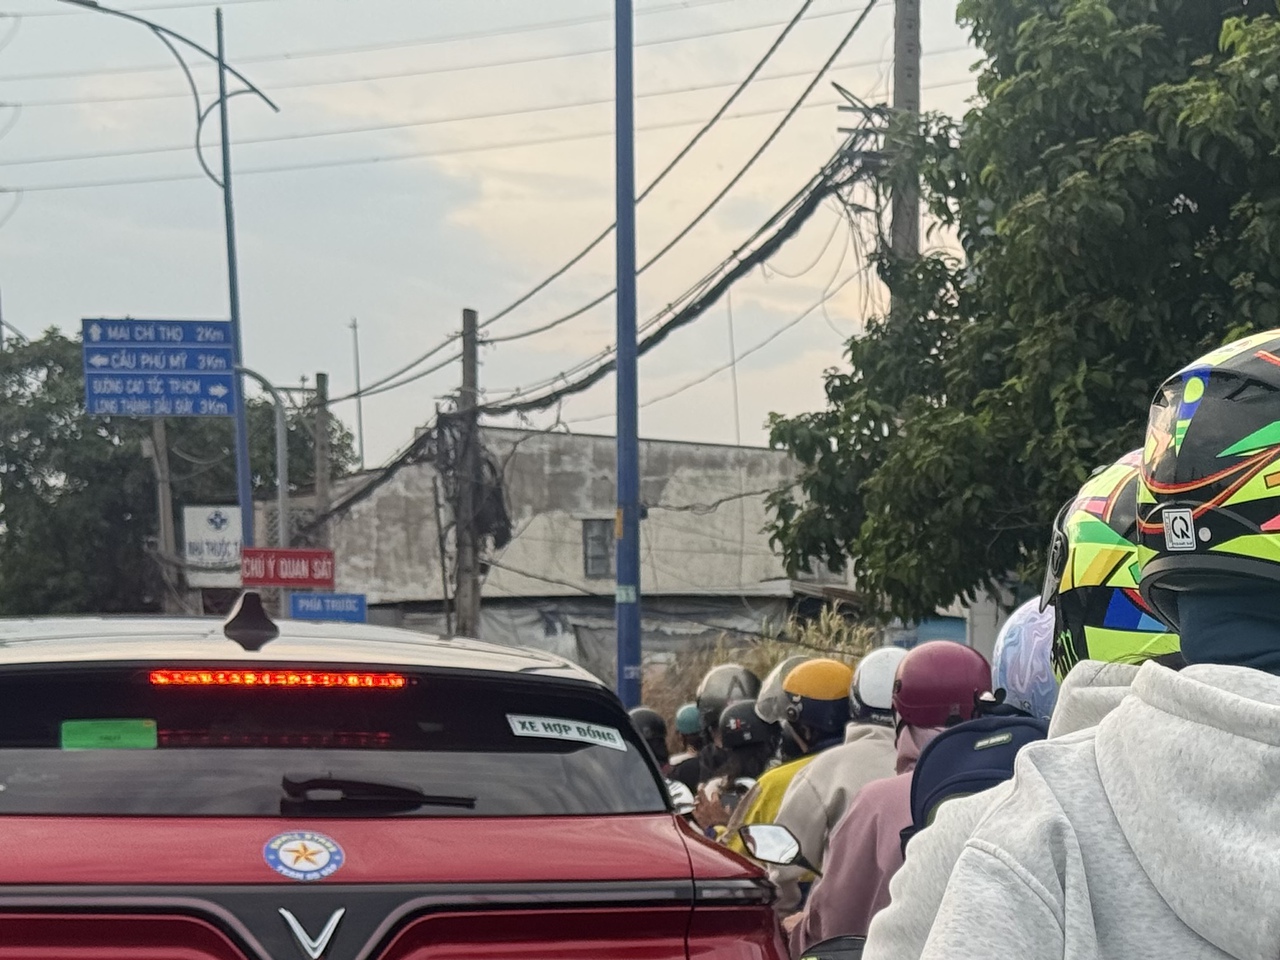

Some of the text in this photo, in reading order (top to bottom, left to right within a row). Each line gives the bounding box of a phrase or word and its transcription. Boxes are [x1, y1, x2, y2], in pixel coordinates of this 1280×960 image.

[107, 325, 130, 341] MAI
[140, 351, 166, 369] PHÚ
[243, 554, 265, 578] CHÚ
[518, 720, 540, 733] XE
[541, 722, 572, 737] HỢP
